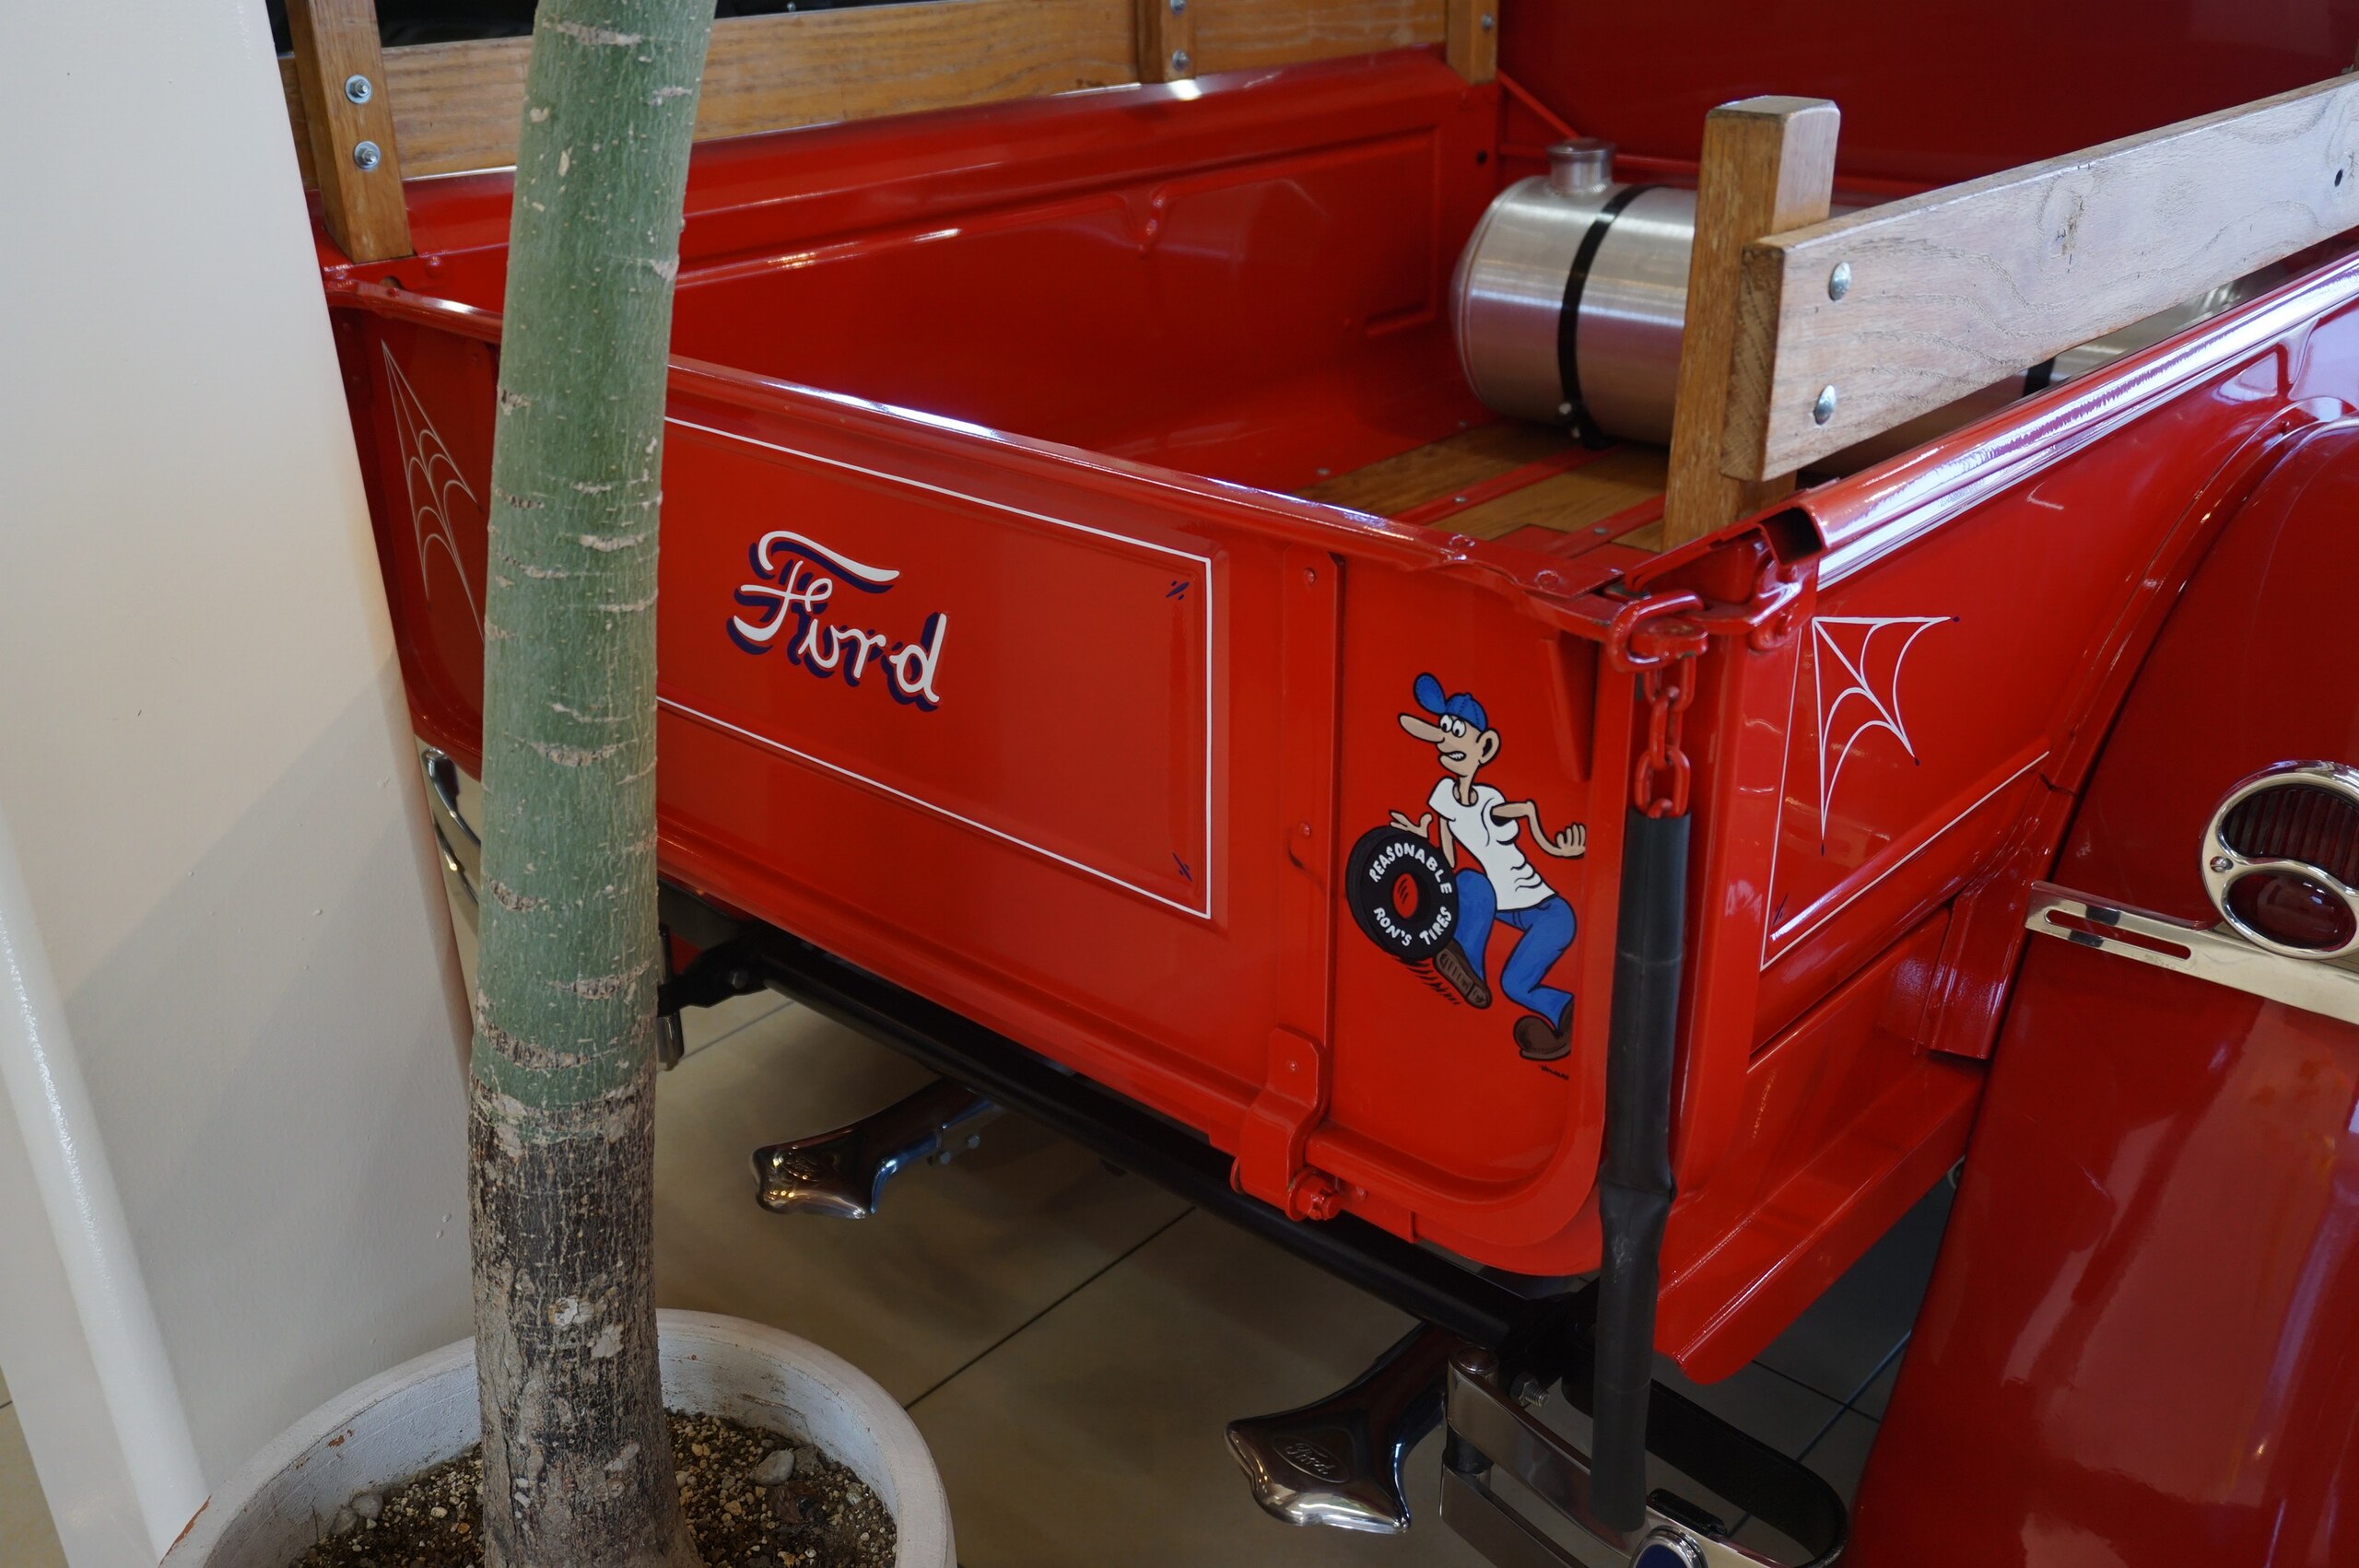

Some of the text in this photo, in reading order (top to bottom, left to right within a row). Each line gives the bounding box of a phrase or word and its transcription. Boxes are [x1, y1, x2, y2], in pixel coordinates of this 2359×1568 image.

[726, 530, 948, 712] Ford
[1368, 842, 1453, 895] REASONABLE
[1373, 906, 1452, 947] RON'S TIRES
[1285, 1443, 1336, 1475] Ford
